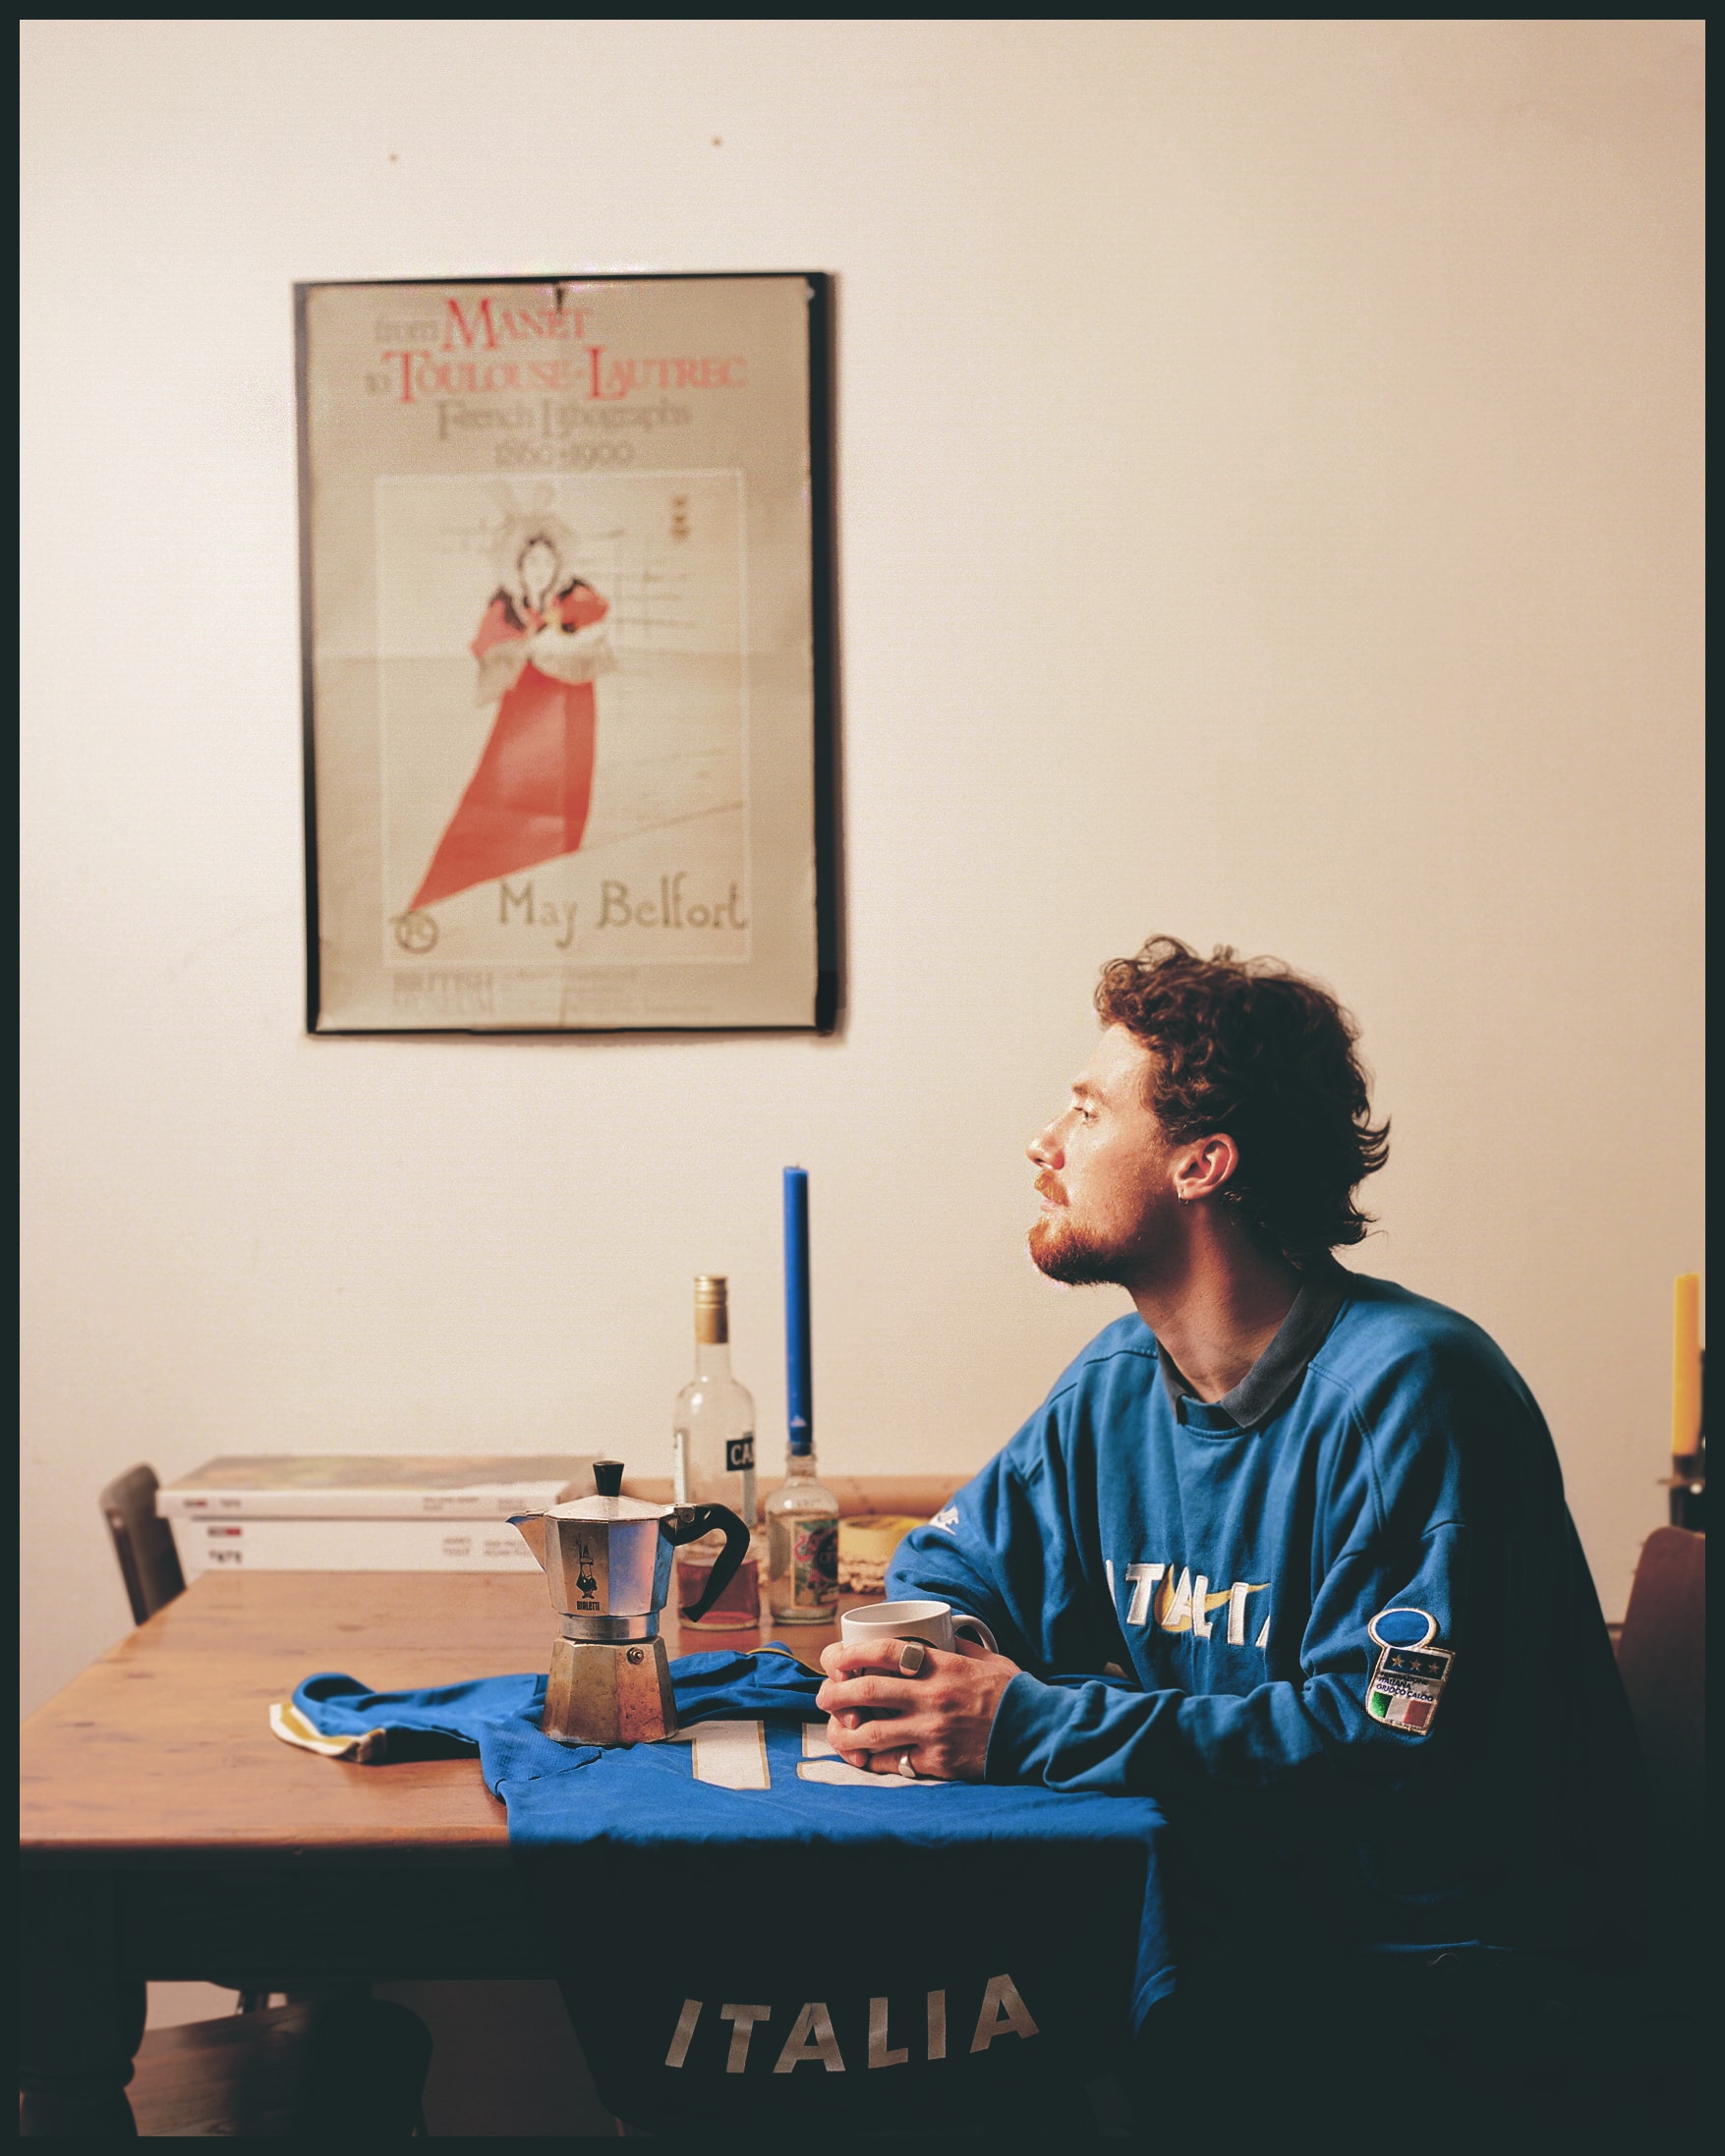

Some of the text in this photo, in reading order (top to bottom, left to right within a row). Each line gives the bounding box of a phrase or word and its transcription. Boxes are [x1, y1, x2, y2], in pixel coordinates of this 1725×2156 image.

[436, 400, 536, 440] French
[498, 879, 578, 948] May
[597, 872, 748, 930] Belfort
[577, 1600, 601, 1612] BIALETTI
[1106, 1559, 1270, 1648] TALI
[664, 1973, 1040, 2073] ITALIA
